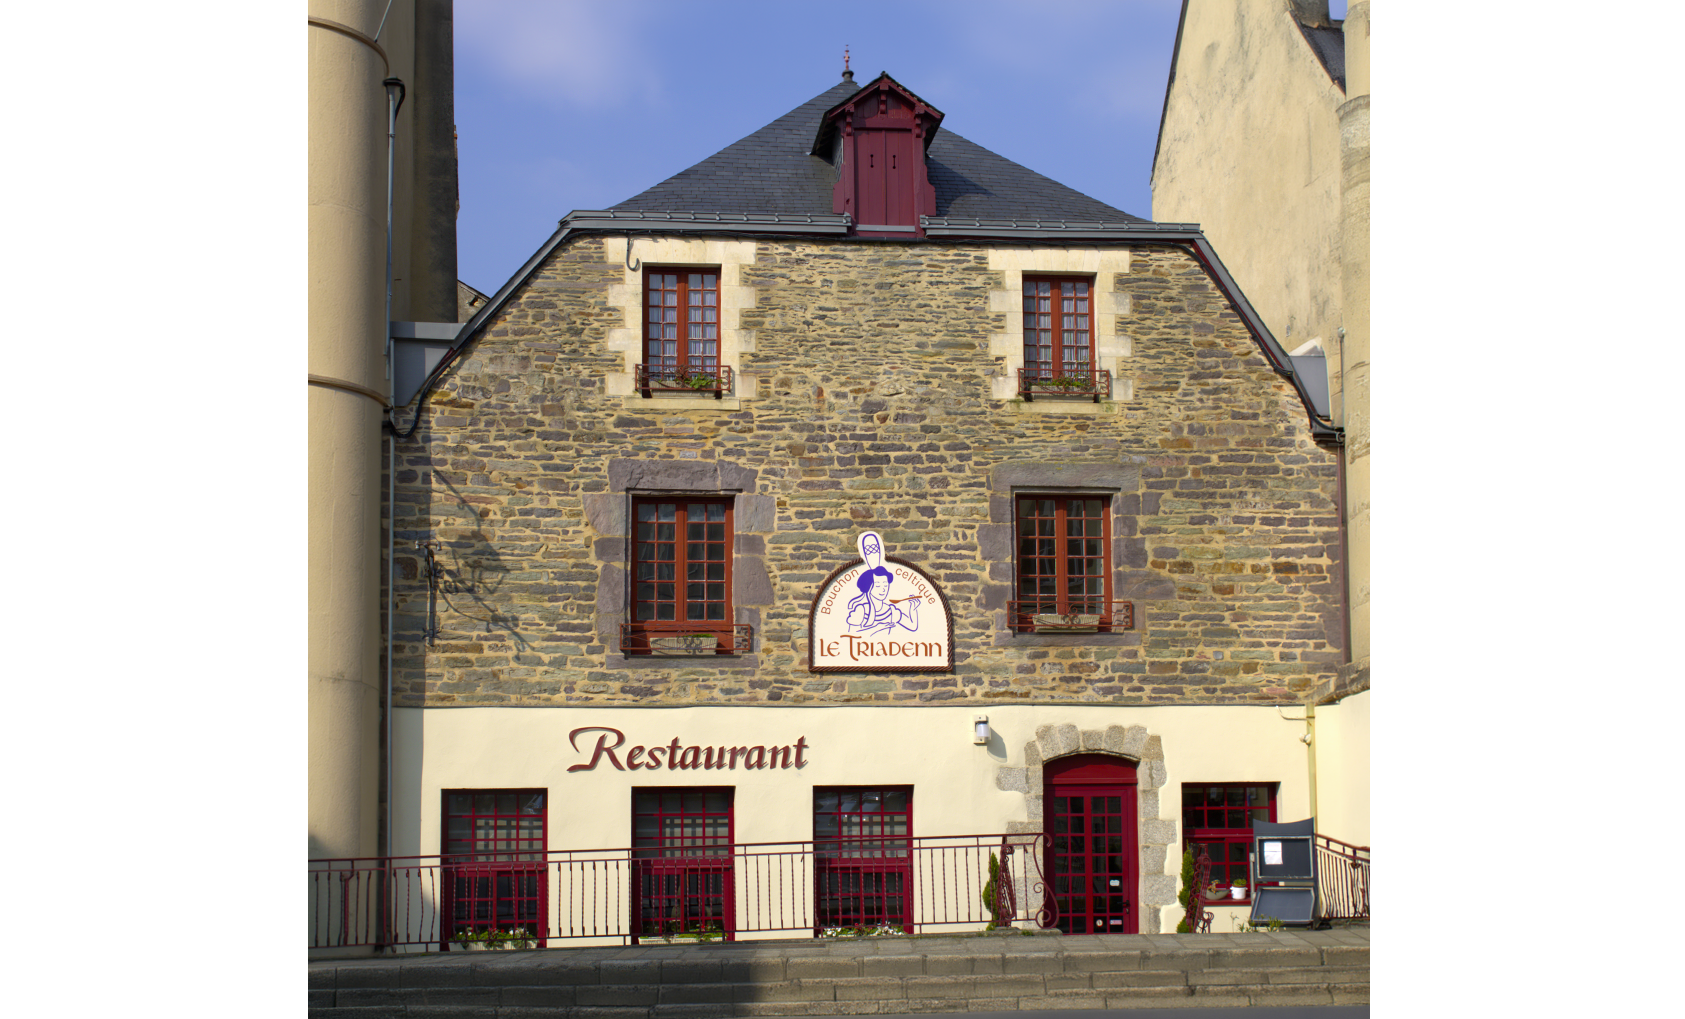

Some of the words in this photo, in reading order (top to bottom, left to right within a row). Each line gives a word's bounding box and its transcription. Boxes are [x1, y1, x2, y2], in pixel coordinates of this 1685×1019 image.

[821, 568, 859, 615] Bouchon
[895, 568, 936, 605] celtique
[566, 726, 809, 773] Restaurant
